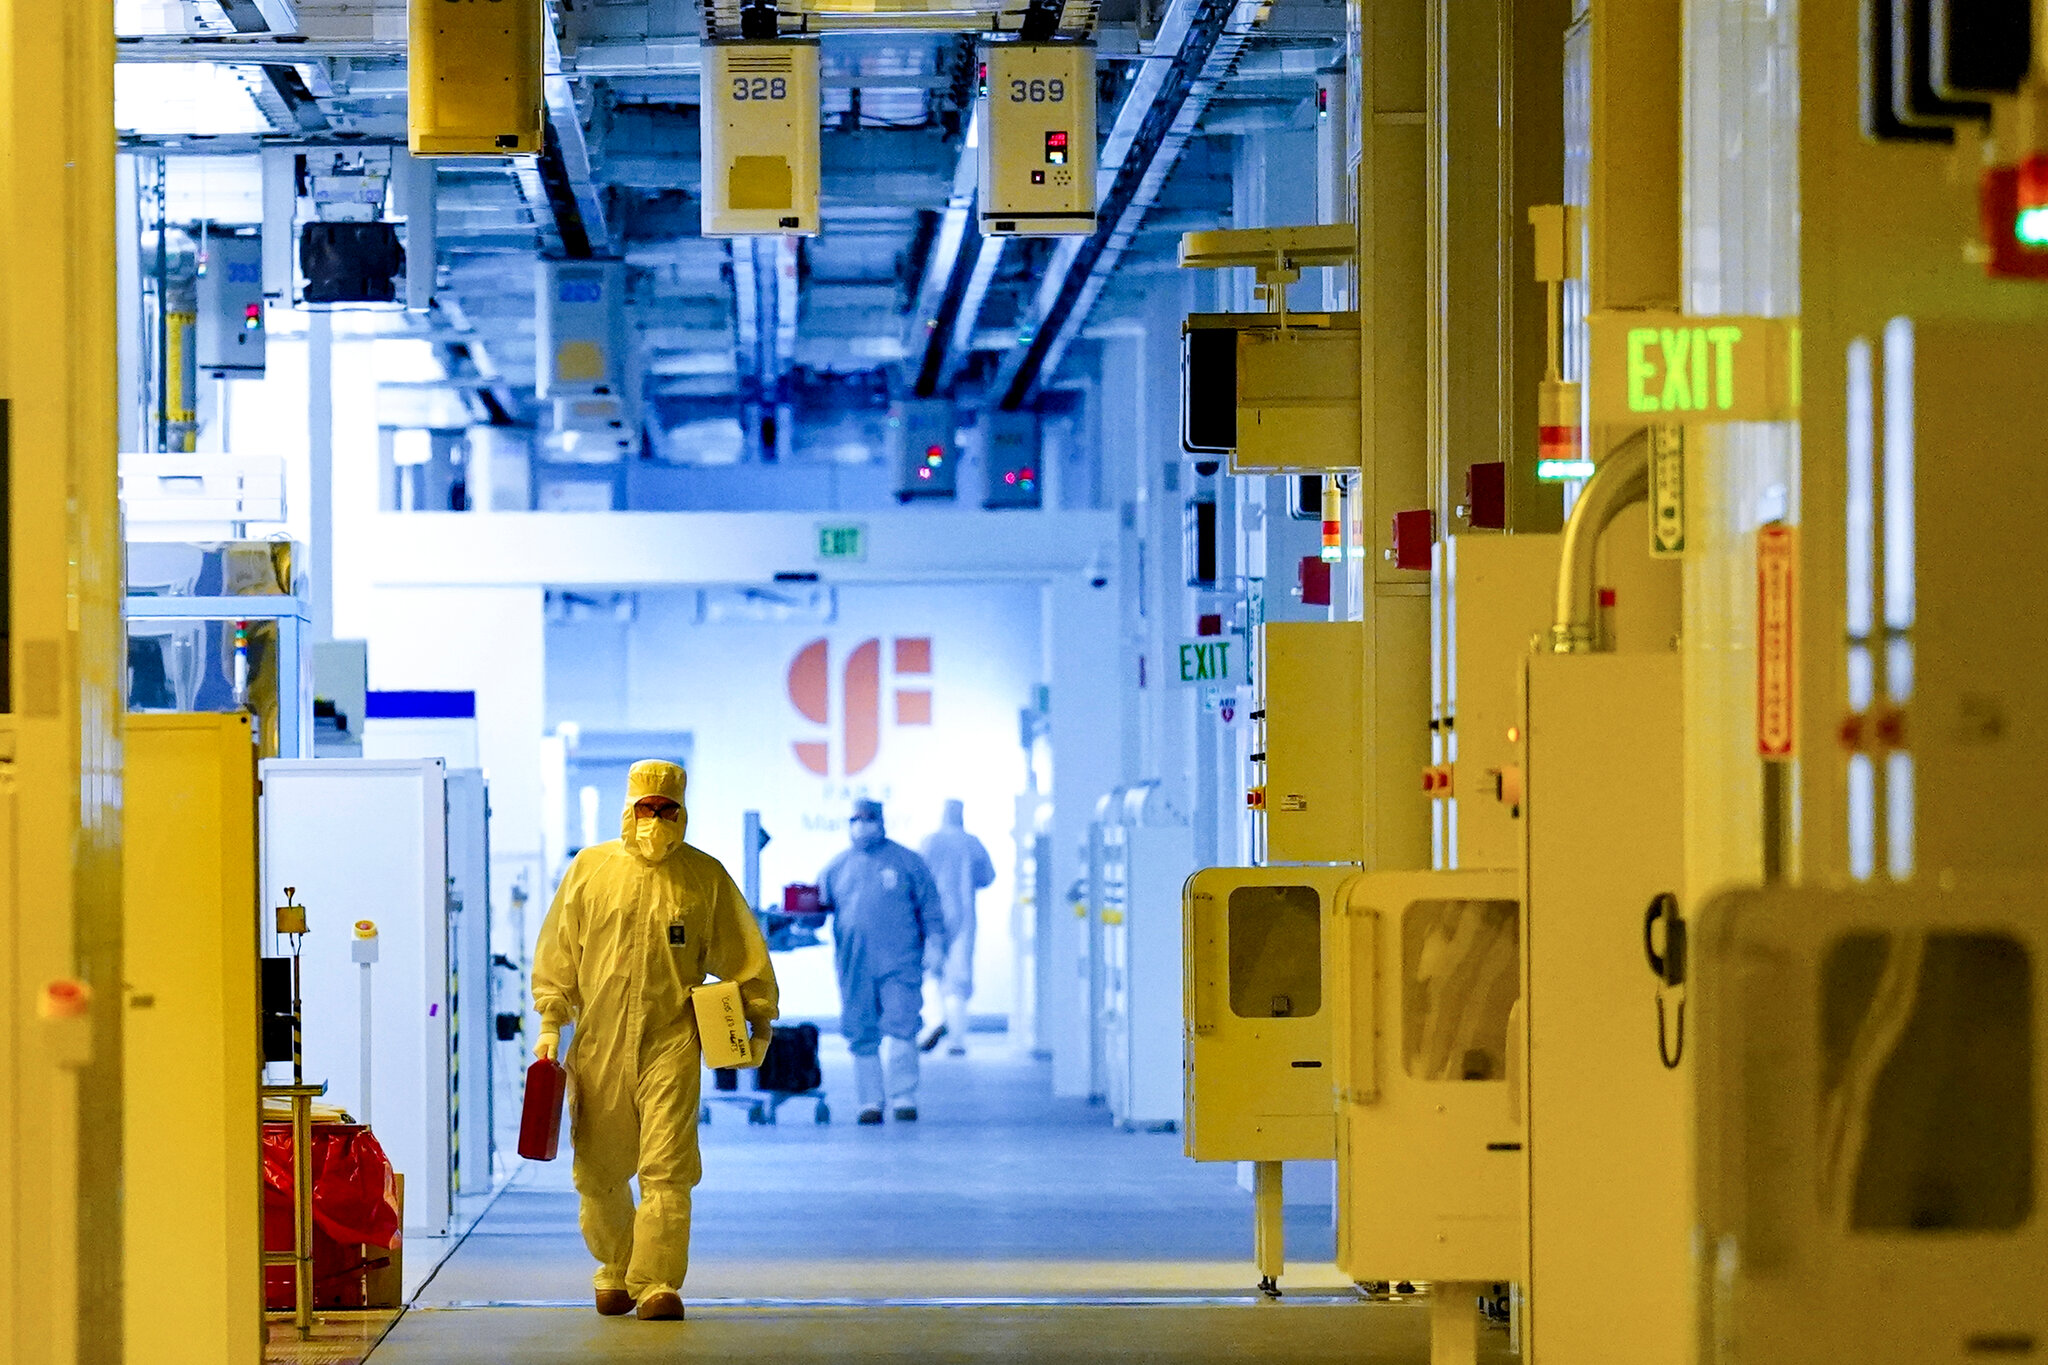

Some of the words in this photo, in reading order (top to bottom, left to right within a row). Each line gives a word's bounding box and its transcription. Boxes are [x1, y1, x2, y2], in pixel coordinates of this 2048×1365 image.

[733, 78, 787, 101] 328
[1010, 79, 1065, 102] 369
[1628, 327, 1741, 412] EXIT
[1180, 641, 1230, 682] EXIT
